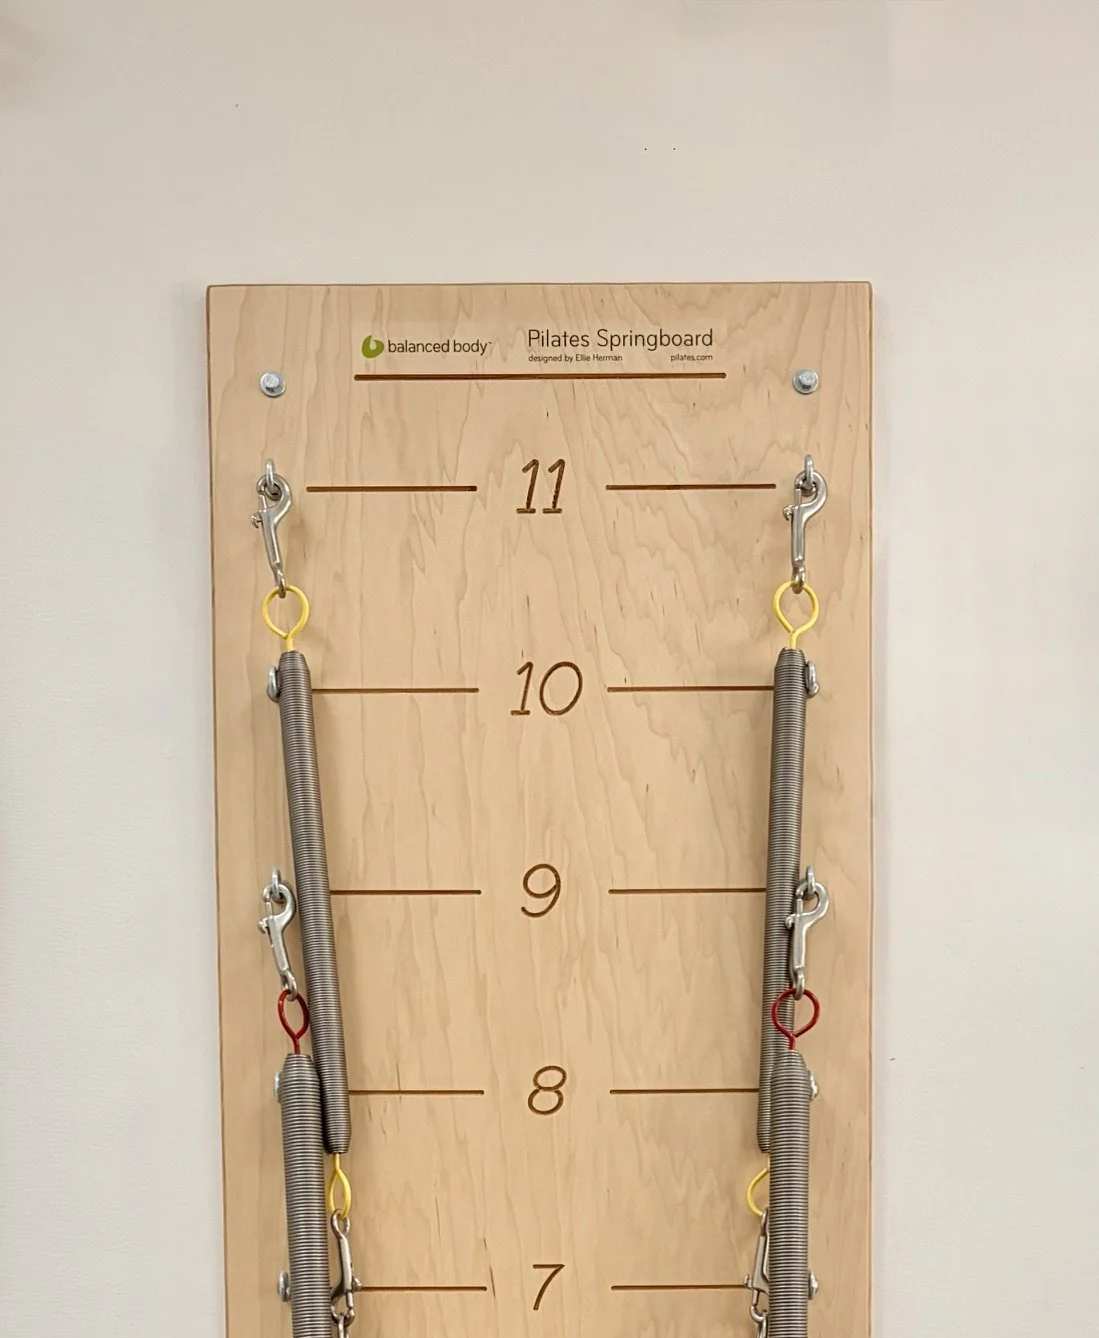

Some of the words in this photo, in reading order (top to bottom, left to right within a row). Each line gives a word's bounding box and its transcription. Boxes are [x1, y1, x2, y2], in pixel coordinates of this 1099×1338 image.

[387, 339, 450, 354] balanced
[453, 339, 488, 357] body
[528, 328, 590, 348] Pilates
[597, 328, 713, 351] Springboard
[528, 353, 562, 363] designed
[564, 353, 573, 363] by
[575, 353, 591, 362] Ellie
[592, 353, 623, 362] Herman
[670, 353, 713, 363] pilates.com
[515, 458, 566, 515] 11
[510, 660, 584, 717] 10
[520, 863, 562, 919] 9
[527, 1065, 568, 1116] 8
[532, 1263, 566, 1311] 7
